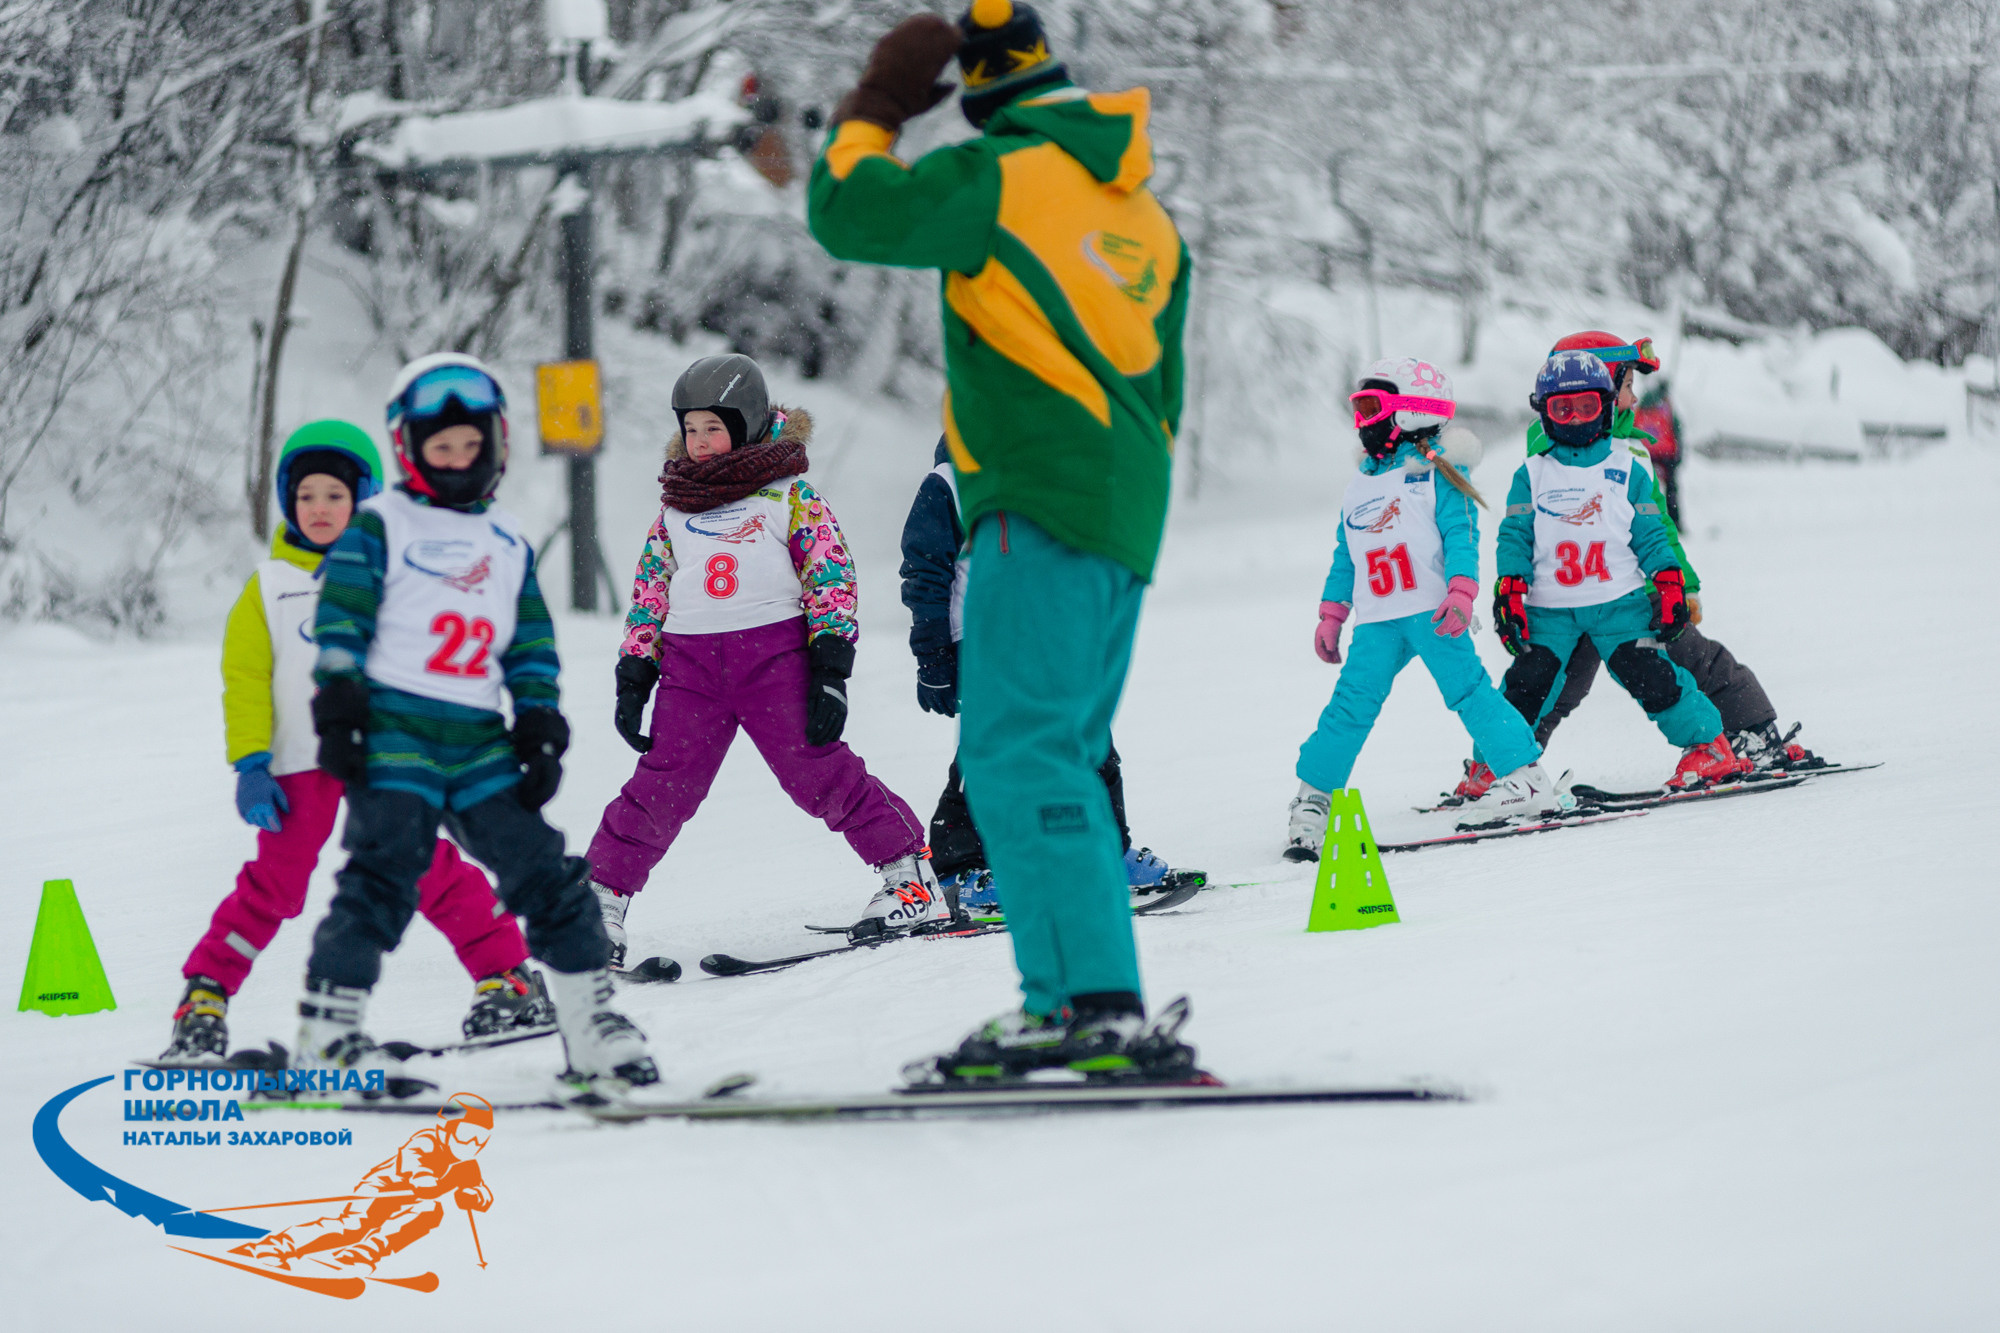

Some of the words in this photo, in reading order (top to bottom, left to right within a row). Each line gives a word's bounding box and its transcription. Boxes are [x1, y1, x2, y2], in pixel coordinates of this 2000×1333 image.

[704, 552, 739, 600] 8
[1365, 542, 1418, 597] 51
[1554, 540, 1613, 587] 34
[425, 611, 495, 678] 22
